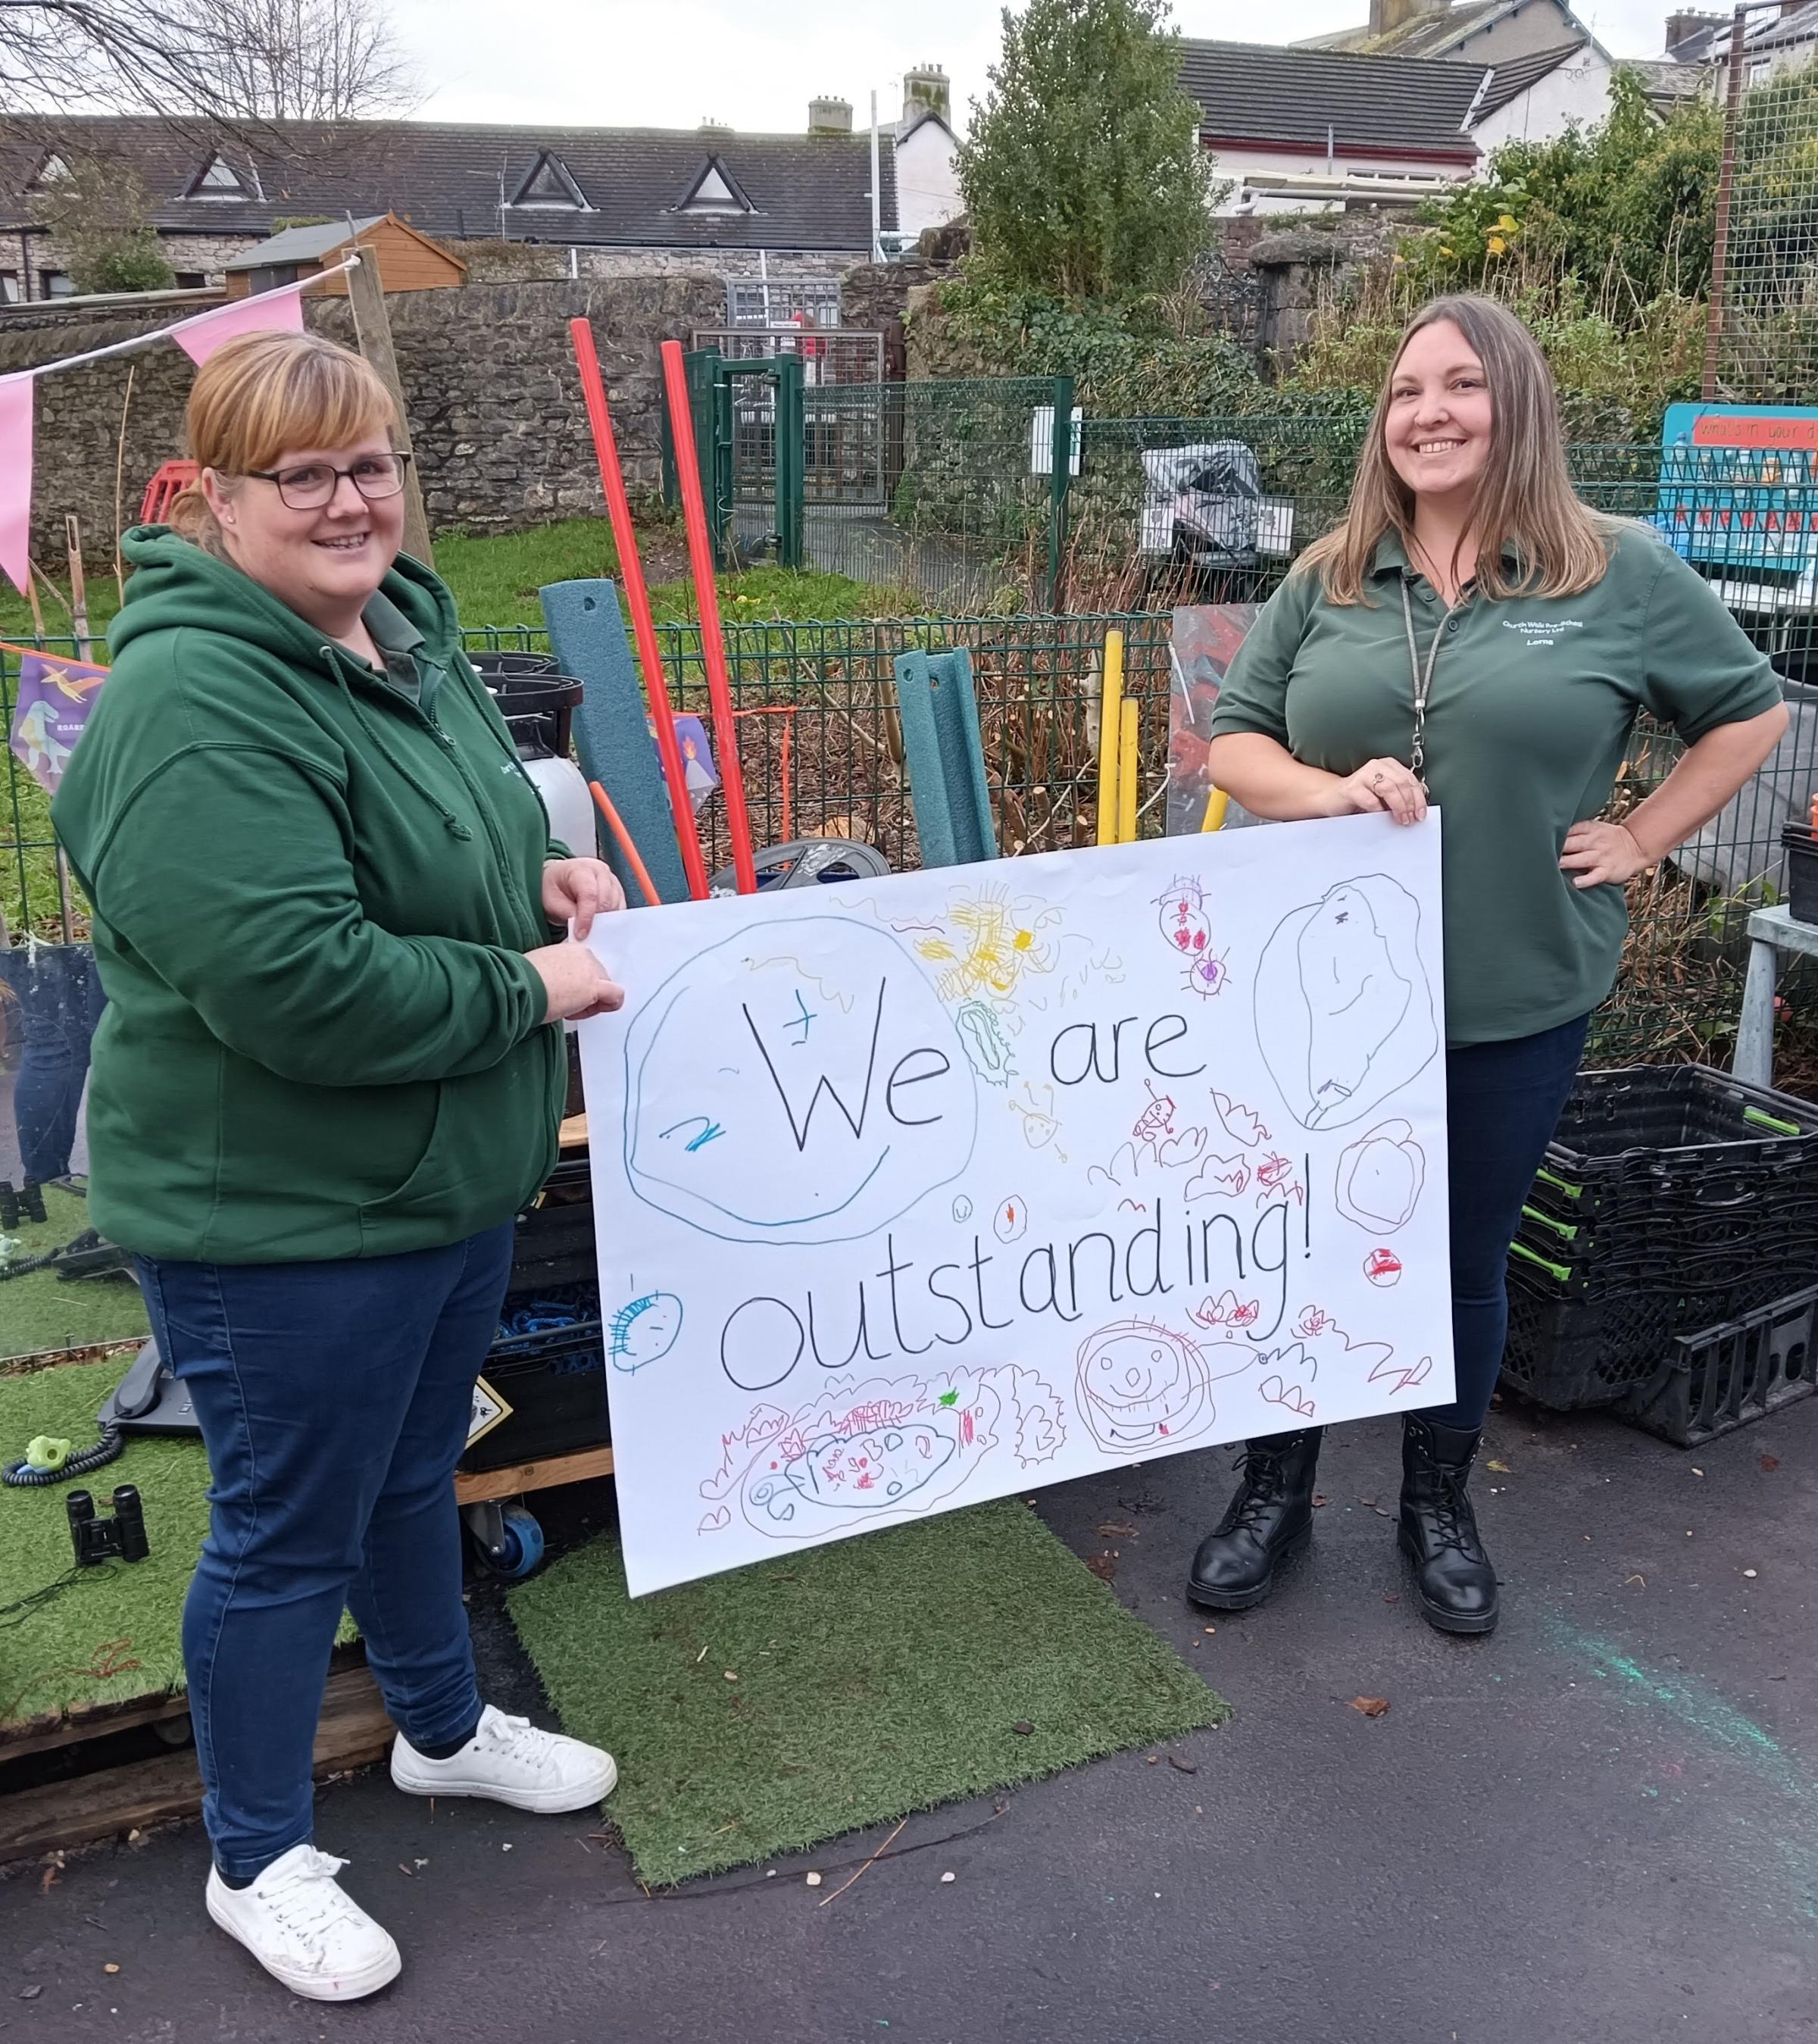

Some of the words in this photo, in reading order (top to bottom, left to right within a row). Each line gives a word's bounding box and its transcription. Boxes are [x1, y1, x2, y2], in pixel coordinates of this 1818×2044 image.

[1768, 425, 1800, 446] your
[742, 976, 951, 1152] We
[1050, 1012, 1207, 1086] are
[720, 1152, 1311, 1392] outstanding!
